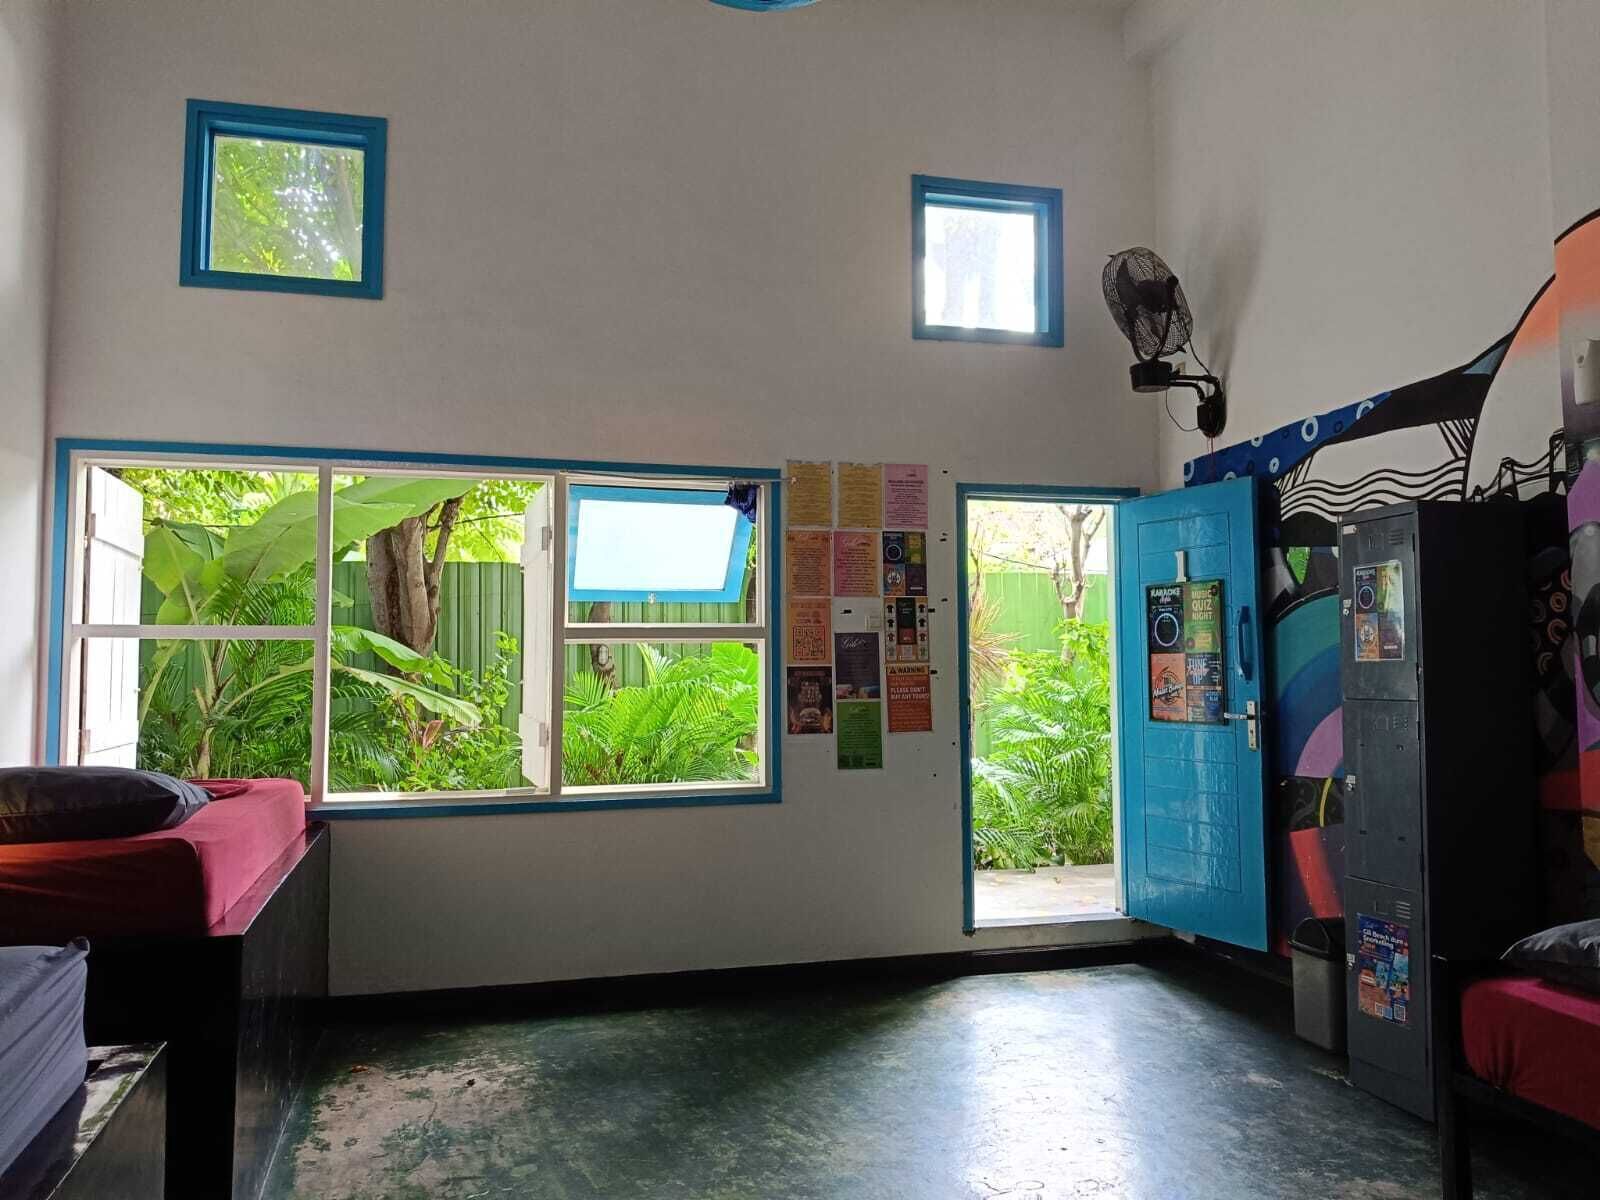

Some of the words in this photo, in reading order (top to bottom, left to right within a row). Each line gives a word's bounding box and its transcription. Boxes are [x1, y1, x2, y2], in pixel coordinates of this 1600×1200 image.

[1175, 550, 1187, 583] 1
[1150, 587, 1181, 597] KARAOKE
[1191, 590, 1212, 599] MUSIC
[1191, 599, 1213, 611] QUIZ
[1191, 611, 1213, 620] NIGHT
[897, 666, 926, 674] WARNING
[1372, 930, 1390, 941] Beach
[1363, 935, 1394, 950] Snorkeling
